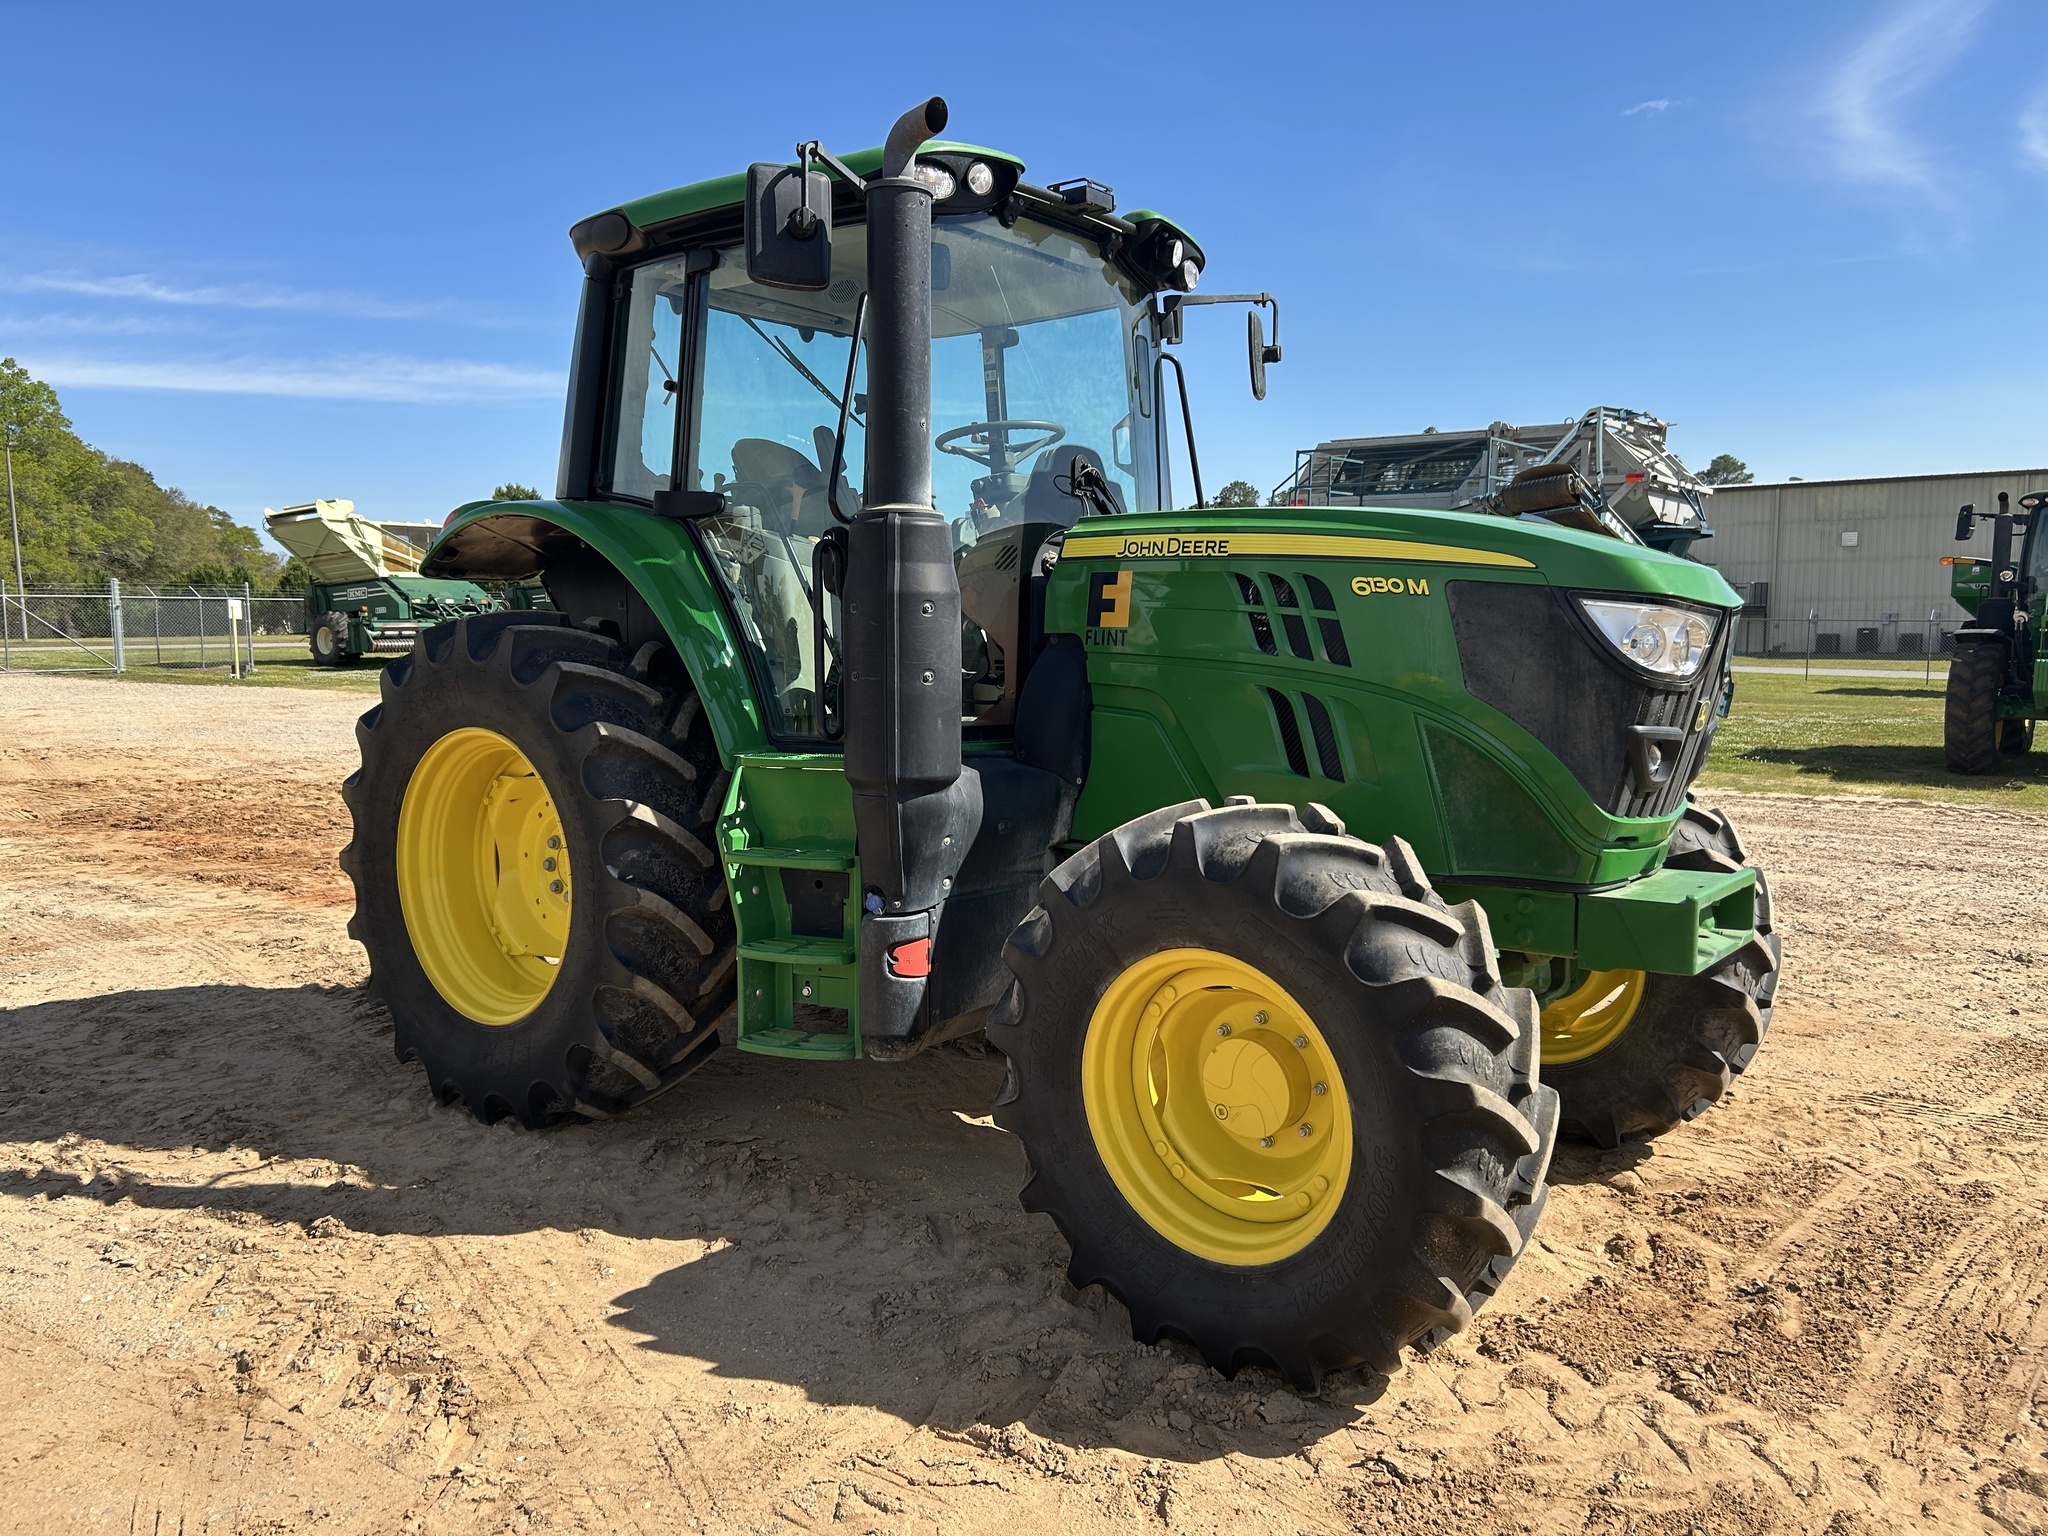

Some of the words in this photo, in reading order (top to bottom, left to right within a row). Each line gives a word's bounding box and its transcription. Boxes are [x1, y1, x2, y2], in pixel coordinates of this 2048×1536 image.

[1116, 538, 1164, 557] JOHN
[1164, 537, 1230, 556] DEERE
[349, 589, 366, 598] KMC
[1085, 628, 1128, 647] FLINT
[1291, 1145, 1398, 1317] 380/85R24
